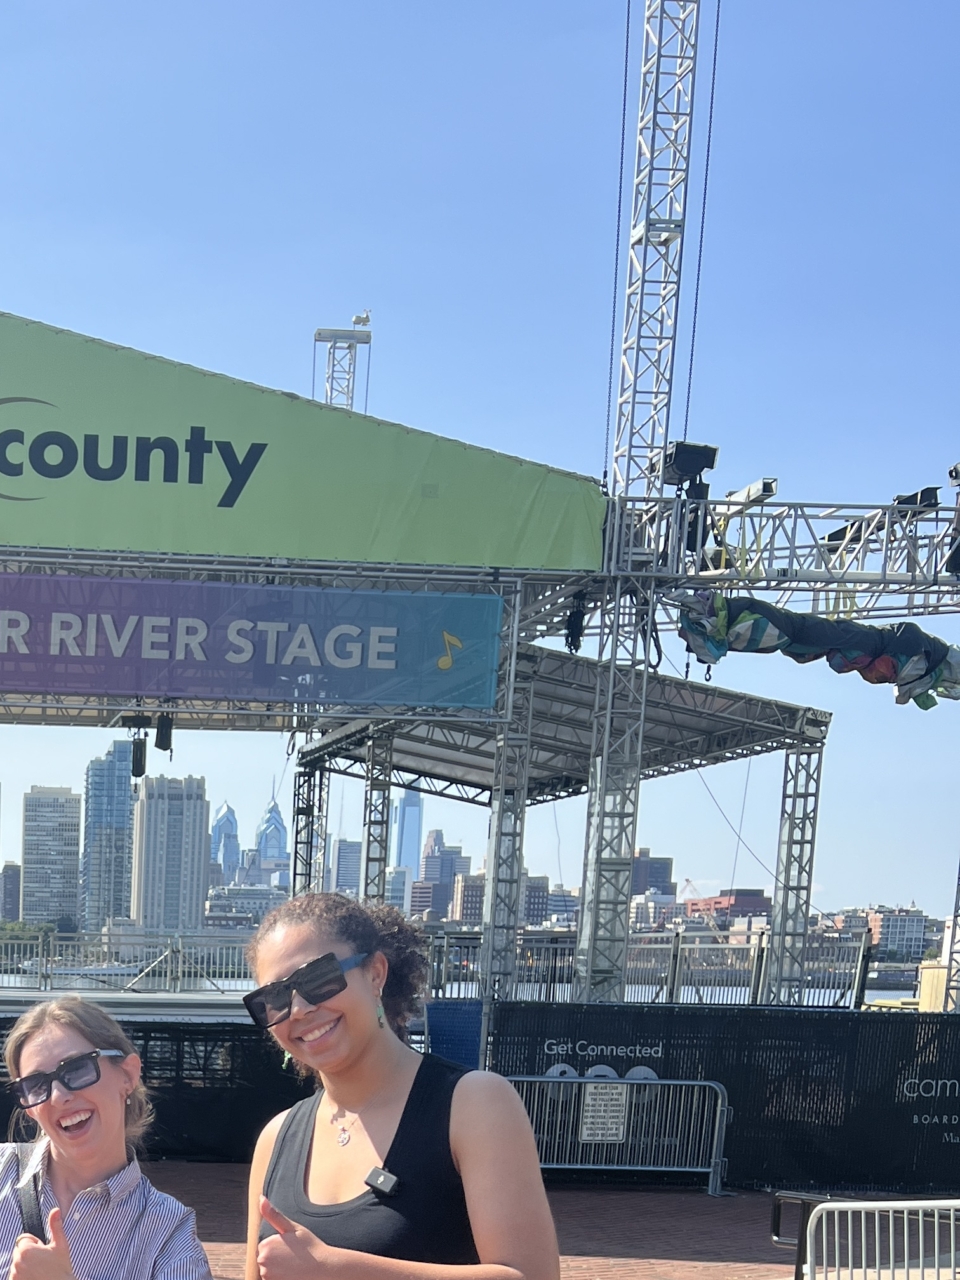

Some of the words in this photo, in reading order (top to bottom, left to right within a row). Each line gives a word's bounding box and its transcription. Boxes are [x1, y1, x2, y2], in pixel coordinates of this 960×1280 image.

[50, 612, 209, 662] RIVER
[224, 620, 399, 670] STAGE
[544, 1040, 572, 1055] Get
[576, 1041, 663, 1057] Connected
[912, 1114, 959, 1124] BOARD
